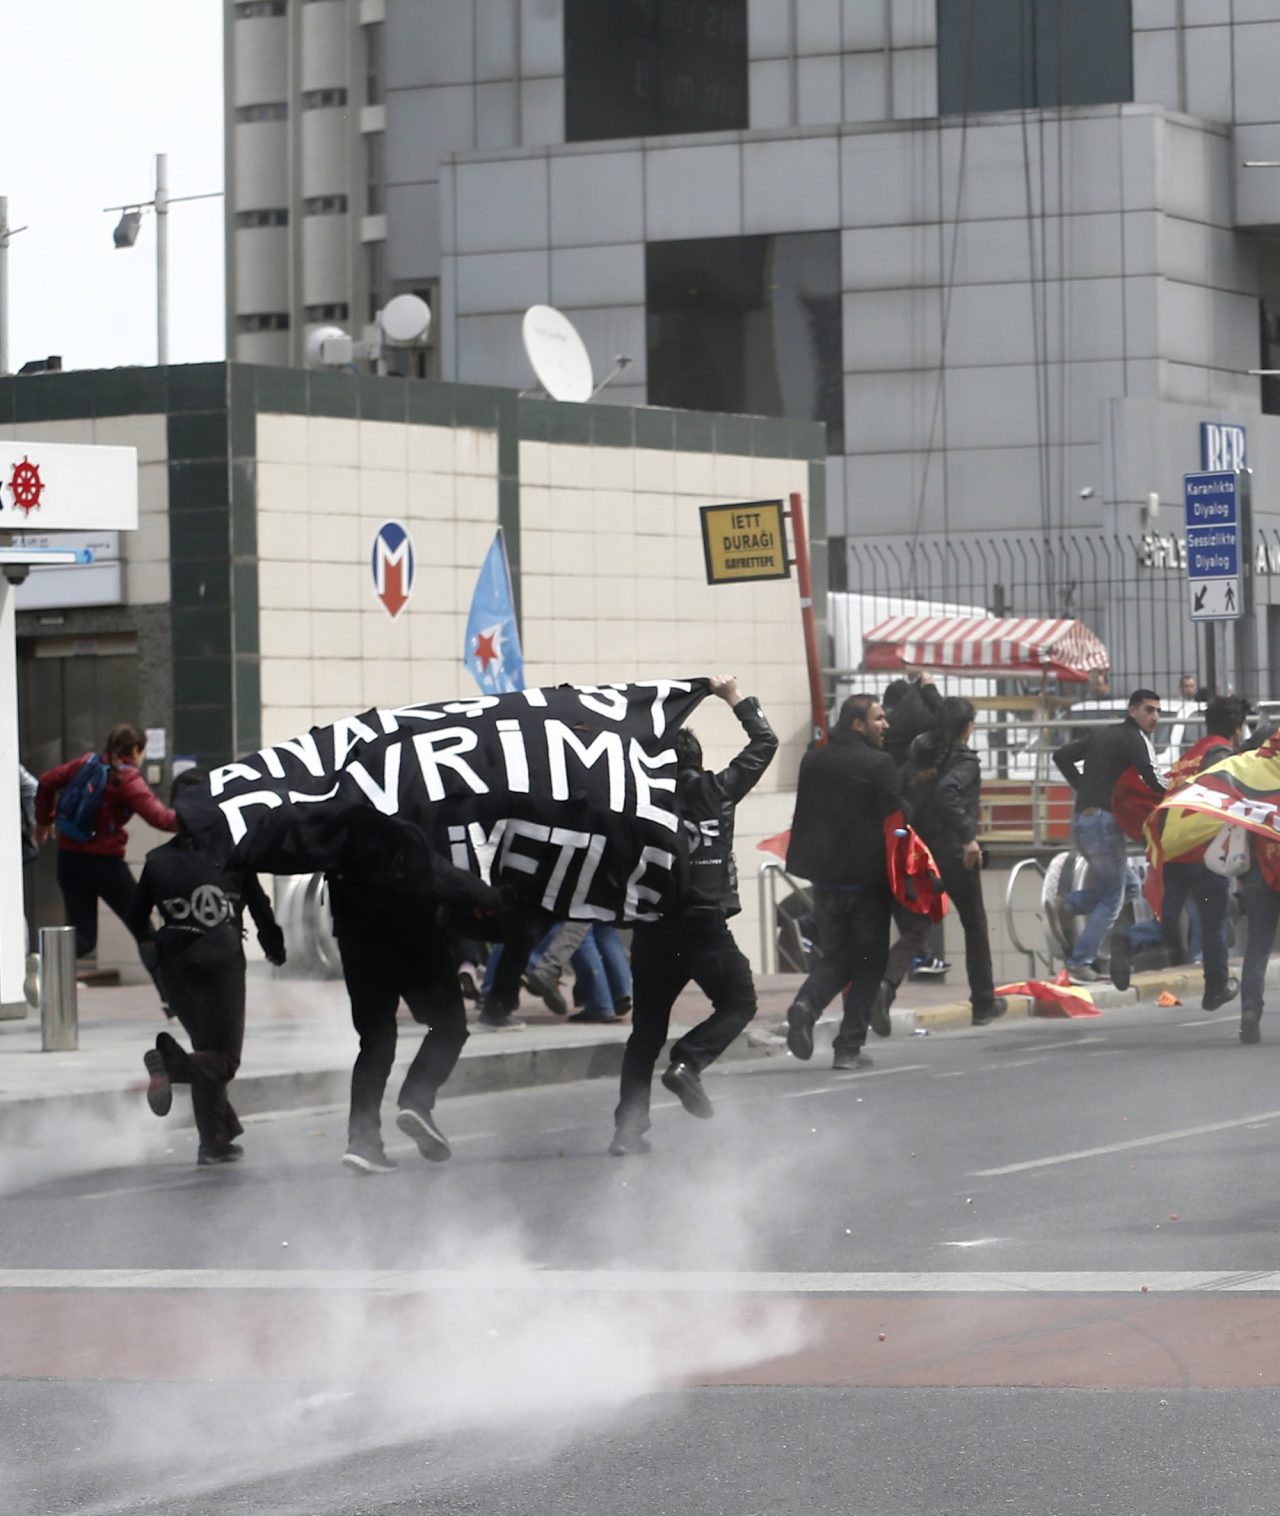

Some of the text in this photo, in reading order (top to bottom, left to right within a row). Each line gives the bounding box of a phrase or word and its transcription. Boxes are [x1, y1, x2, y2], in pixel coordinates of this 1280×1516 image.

[1194, 502, 1229, 518] Diyalog
[731, 511, 761, 530] İETT
[723, 530, 774, 552] DURAĞI
[725, 555, 775, 570] GAYRETTEPE
[1195, 554, 1230, 571] Diyalog
